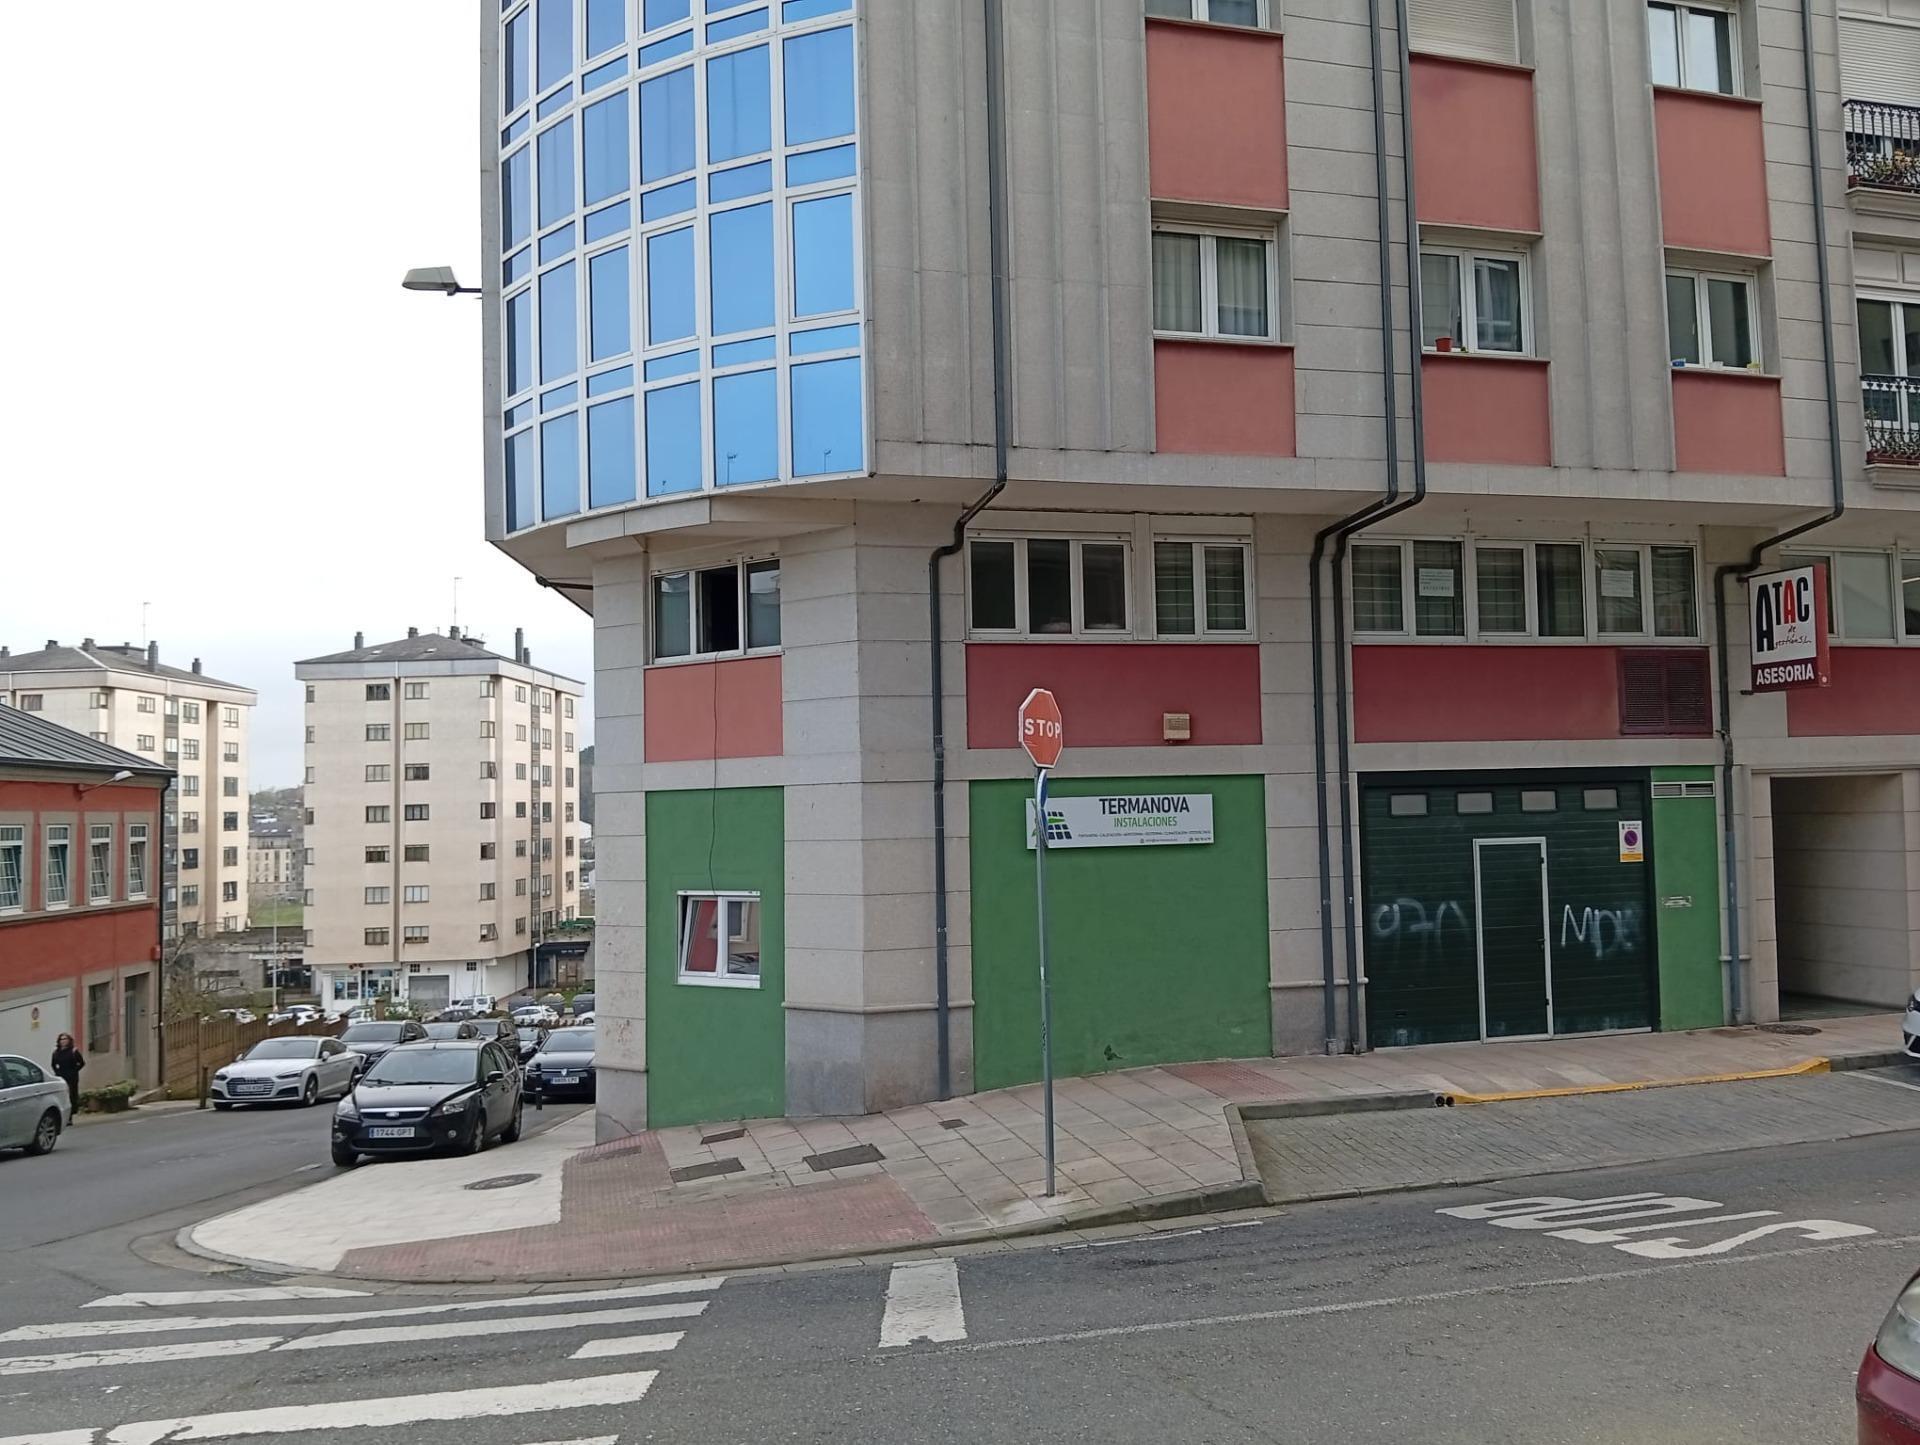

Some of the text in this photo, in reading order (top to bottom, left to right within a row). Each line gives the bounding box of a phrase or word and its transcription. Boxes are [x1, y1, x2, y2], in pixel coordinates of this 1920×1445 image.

[1756, 577, 1810, 652] ATAC
[1756, 663, 1815, 686] ASESORIA
[1024, 718, 1061, 739] STOP
[1099, 796, 1190, 815] TERMANOVA
[1113, 816, 1178, 828] INSTALACIONES
[1435, 1191, 1878, 1259] STOP
